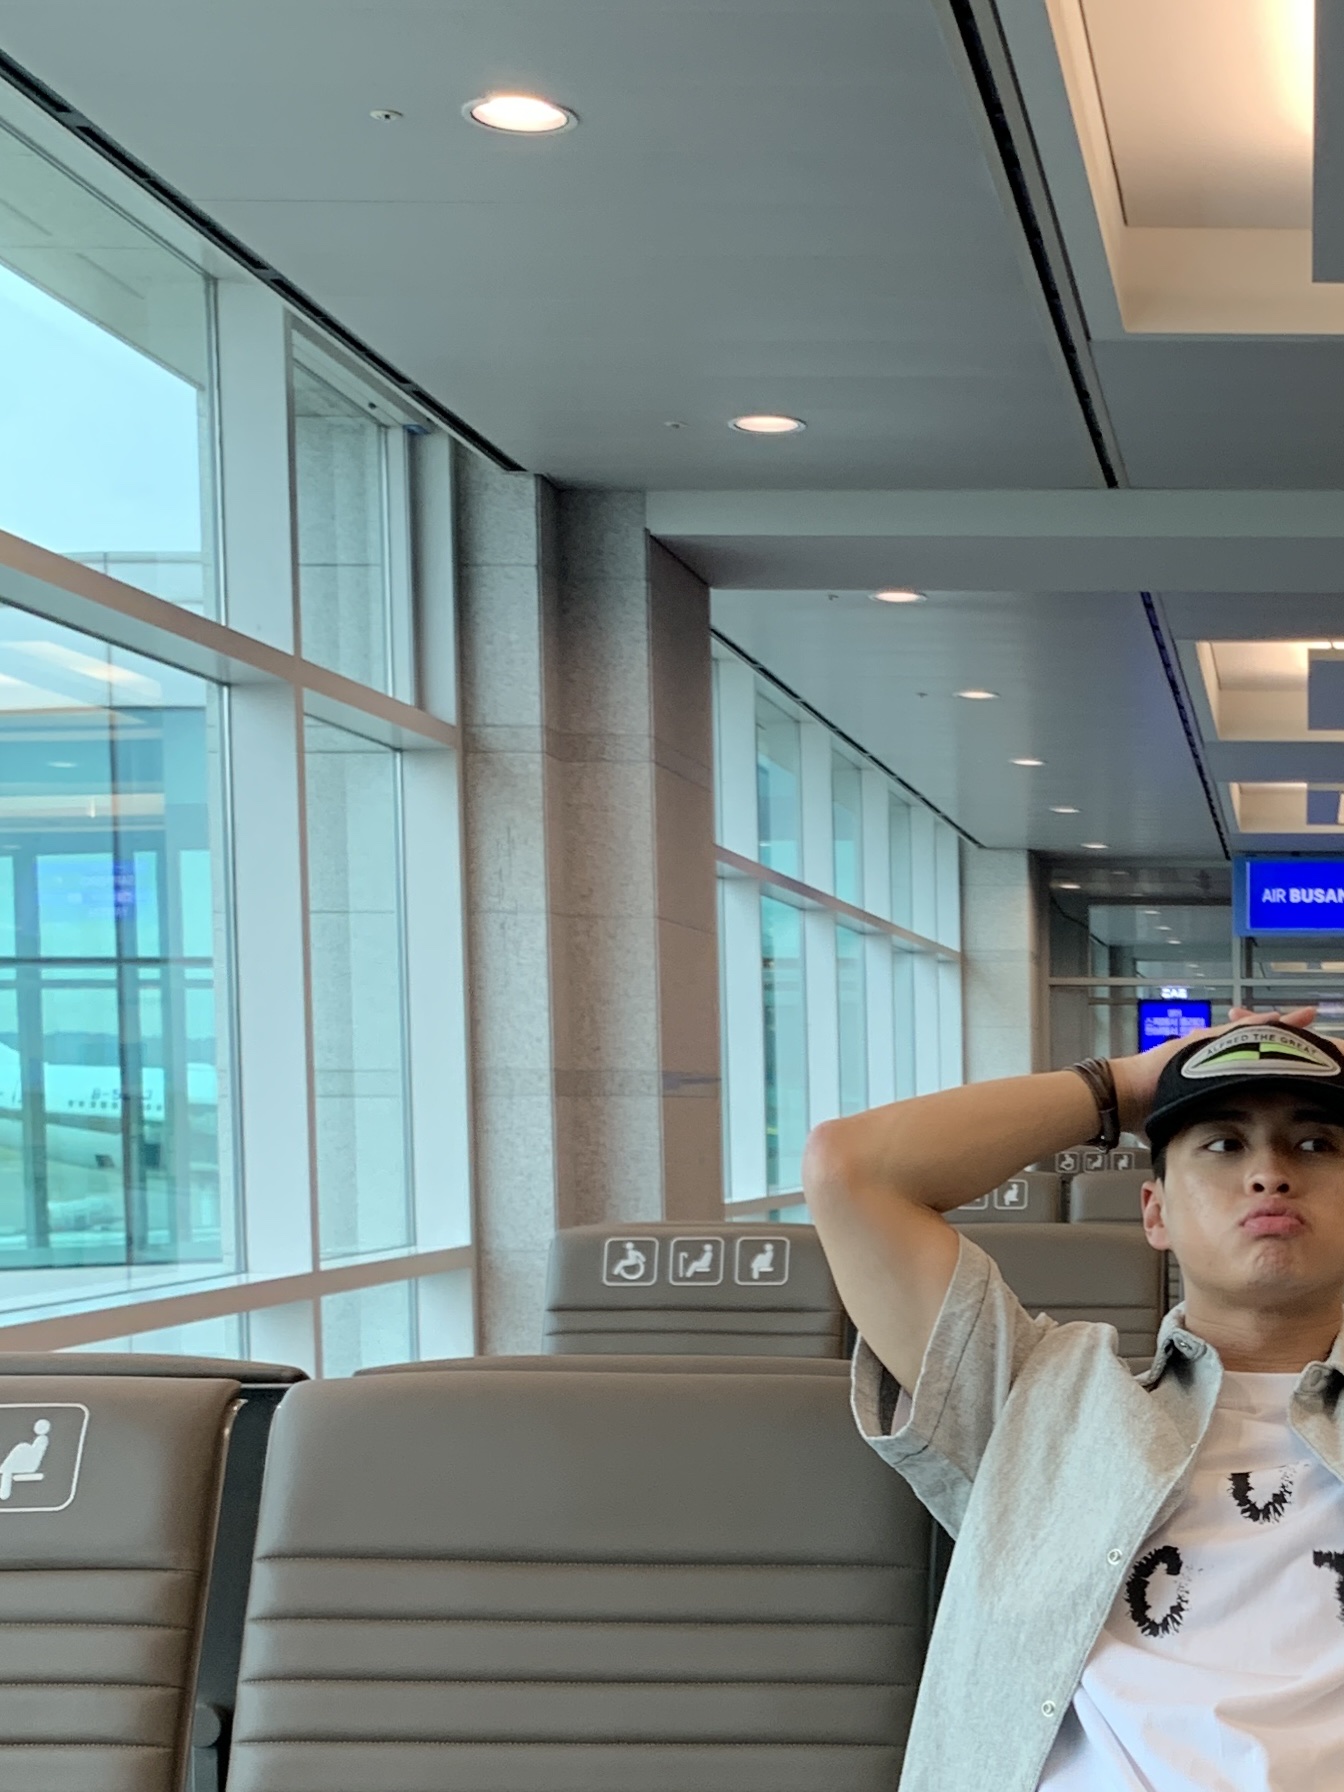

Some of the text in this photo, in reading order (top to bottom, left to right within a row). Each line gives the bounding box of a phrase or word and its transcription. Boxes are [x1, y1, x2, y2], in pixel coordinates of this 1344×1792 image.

[1261, 887, 1287, 904] AIR
[1206, 1033, 1318, 1056] ALFRED THE GREAT
